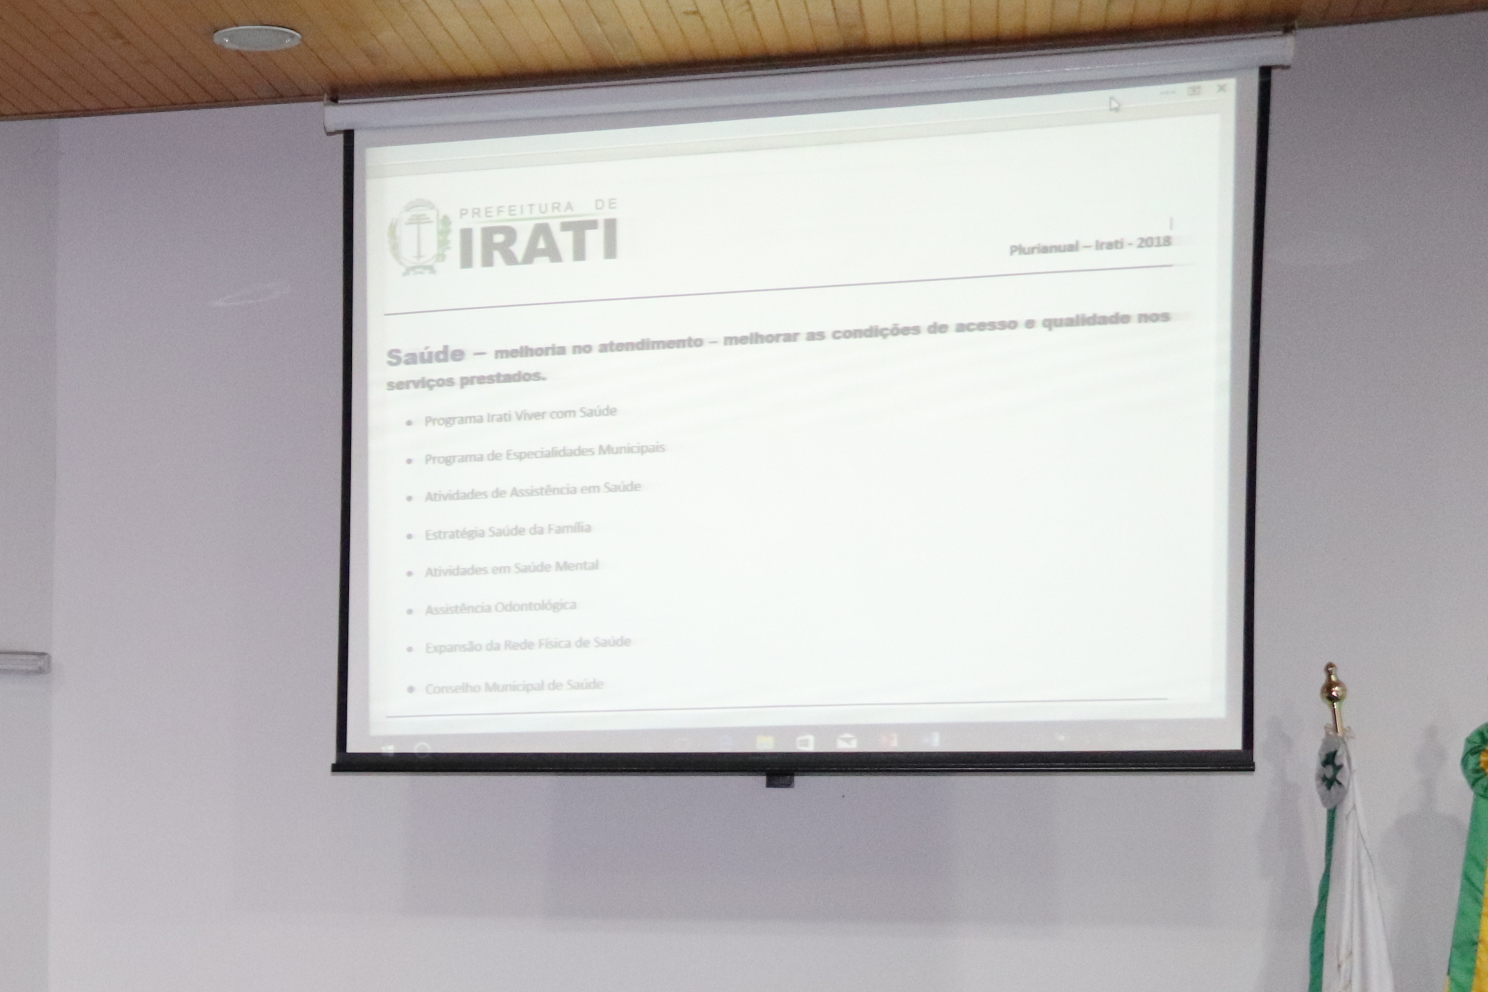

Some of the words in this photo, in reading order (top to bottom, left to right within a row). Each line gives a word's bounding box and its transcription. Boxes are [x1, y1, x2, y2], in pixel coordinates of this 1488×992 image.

[459, 201, 575, 219] PREFEITURA
[594, 197, 617, 211] DE
[459, 218, 618, 269] IRATI
[1009, 240, 1081, 256] Plurianual
[1094, 238, 1125, 251] Irati
[1136, 235, 1173, 249] 2018
[386, 345, 466, 367] Saúde
[494, 344, 567, 359] melhoria
[571, 344, 594, 355] no
[598, 336, 705, 353] atendimento
[723, 332, 801, 346] melhorar
[805, 331, 827, 342] as
[831, 323, 922, 340] condições
[926, 321, 950, 334] de
[954, 320, 1020, 333] acesso
[1023, 319, 1037, 329] e
[1041, 312, 1132, 332] qualidade
[1136, 312, 1172, 324] nos
[386, 376, 456, 391] serviços
[459, 370, 547, 389] prestados.
[424, 415, 485, 428] Programa
[486, 410, 513, 423] Irati
[514, 409, 548, 421] Viver
[548, 409, 577, 420] com
[579, 405, 618, 418] Saúde
[425, 453, 486, 467] Programa
[486, 450, 503, 461] de
[505, 445, 596, 462] Especialidades
[598, 441, 666, 456] Municipais
[424, 488, 489, 502] Atividades
[490, 487, 508, 499] de
[509, 483, 578, 498] Assistência
[579, 485, 601, 494] em
[603, 480, 643, 493] Saúde
[425, 527, 487, 541] Estratégia
[488, 524, 527, 538] Saúde
[528, 523, 545, 536] da
[547, 521, 593, 535] Família
[424, 564, 489, 578] Atividades
[490, 565, 512, 575] em
[514, 561, 553, 574] Saúde
[554, 559, 600, 572] Mental
[425, 602, 493, 616] Assistência
[494, 599, 578, 613] Odontológica
[425, 640, 484, 655] Expansão
[484, 640, 502, 652] da
[503, 638, 537, 651] Rede
[536, 637, 573, 649] Física
[574, 636, 591, 648] de
[593, 635, 632, 648] Saúde
[424, 682, 483, 695] Conselho
[484, 680, 546, 694] Municipal
[546, 679, 564, 691] de
[566, 678, 605, 690] Saúde
